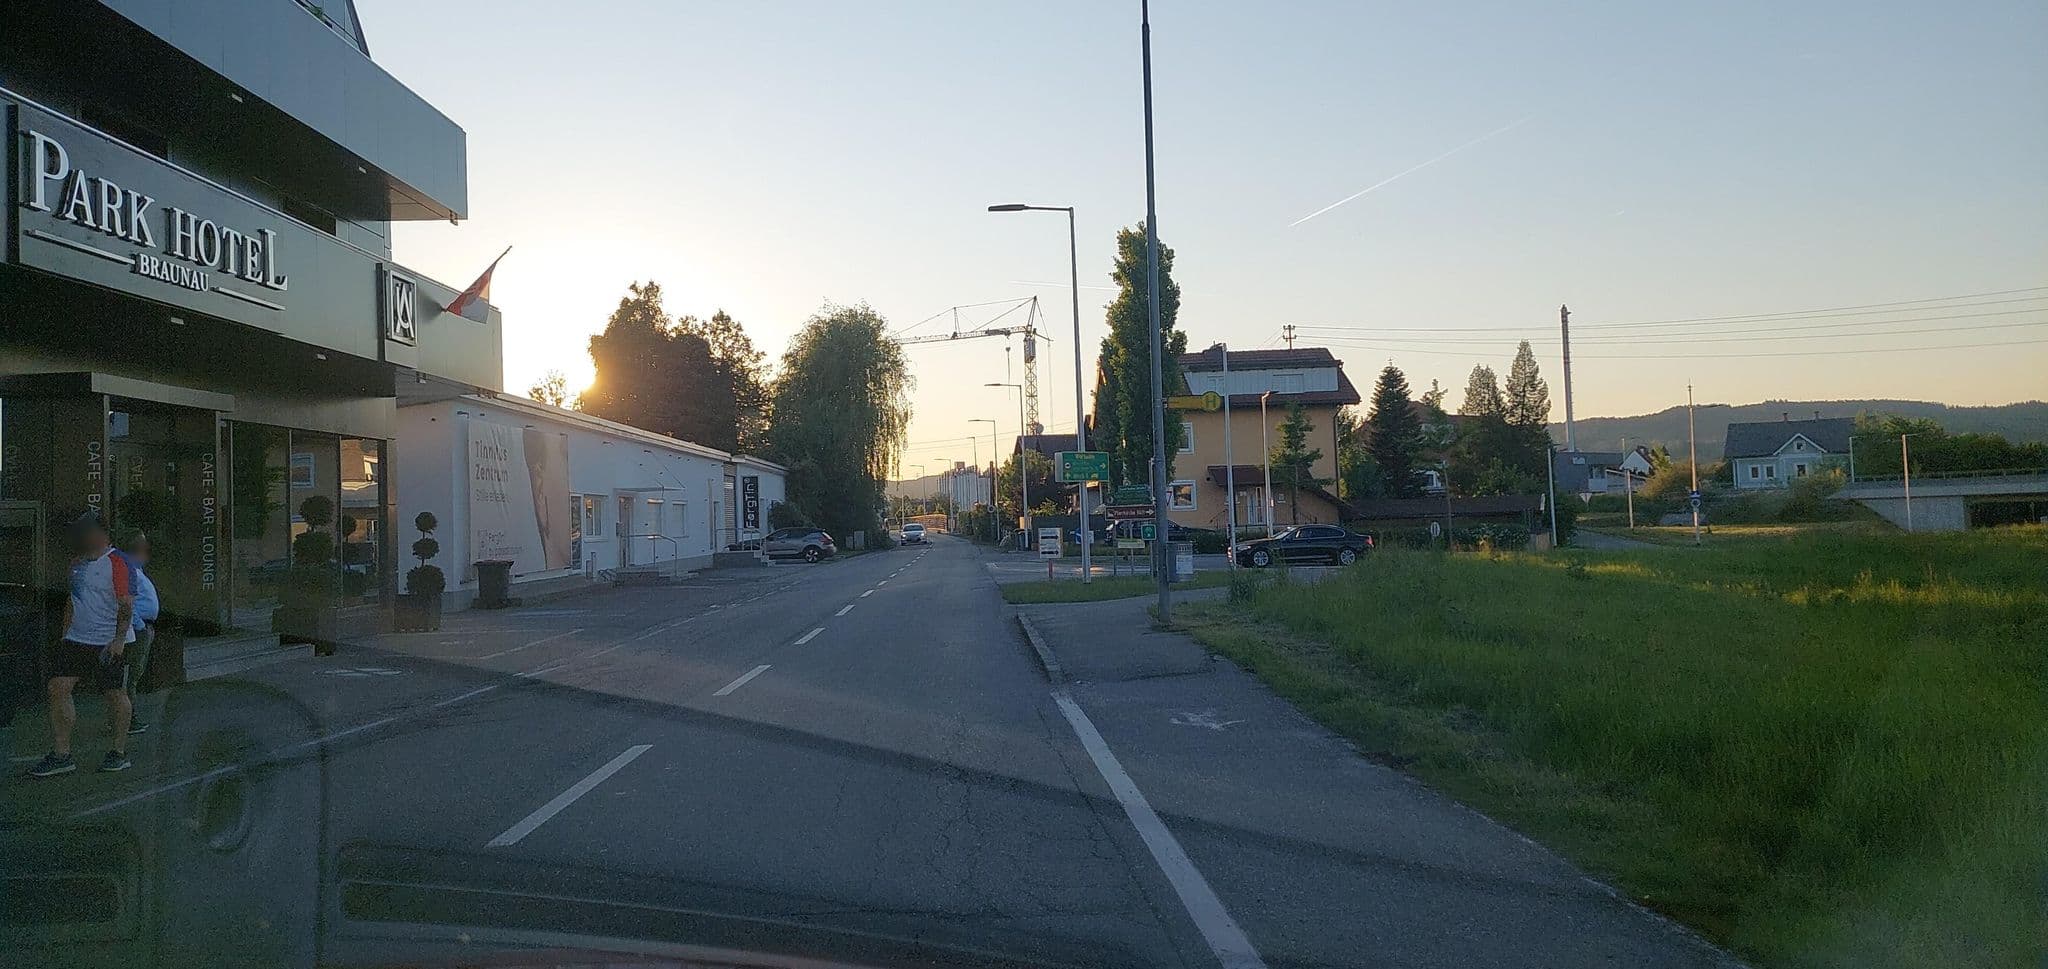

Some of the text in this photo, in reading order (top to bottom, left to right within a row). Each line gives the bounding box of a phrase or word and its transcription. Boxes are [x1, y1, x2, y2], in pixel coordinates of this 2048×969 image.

[29, 129, 289, 291] PARK HOTEL
[139, 253, 210, 293] BRAUNAU
[87, 441, 101, 481] CAFE
[201, 452, 215, 486] CAFE
[475, 463, 509, 483] Zentrum
[202, 496, 215, 525] BAR
[202, 536, 216, 591] LOUNGE
